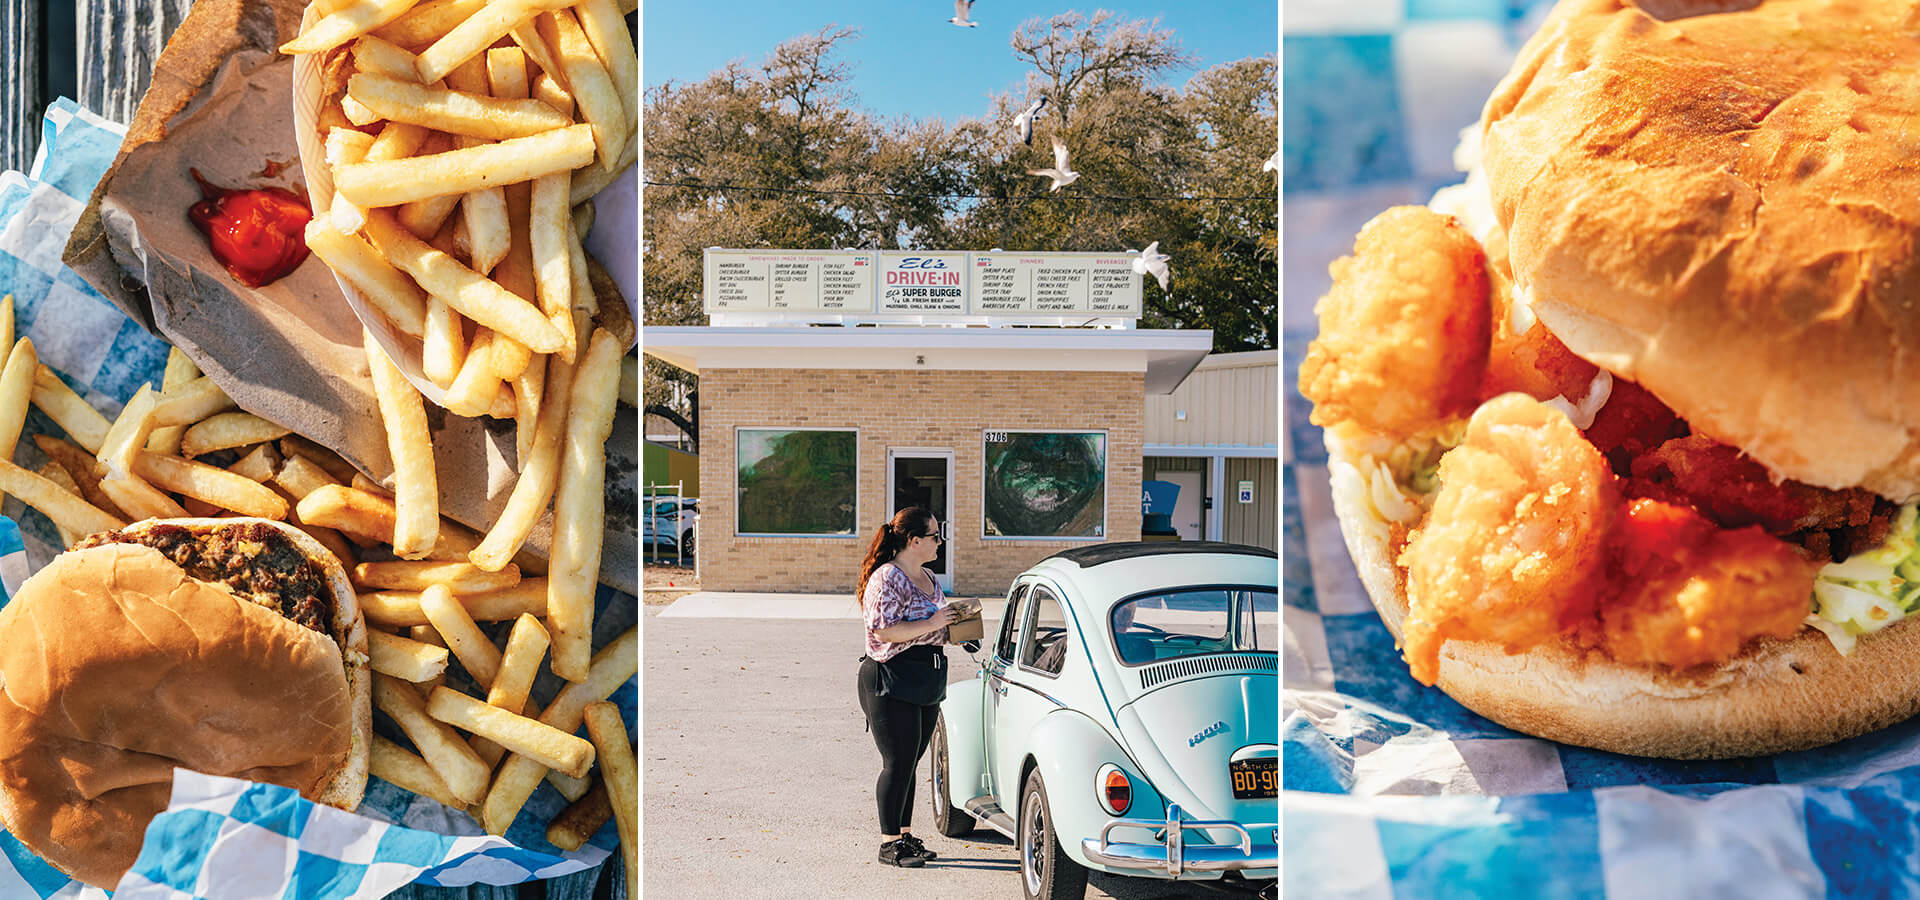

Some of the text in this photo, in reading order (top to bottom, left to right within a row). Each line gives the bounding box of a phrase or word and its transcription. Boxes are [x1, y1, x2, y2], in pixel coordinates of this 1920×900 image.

[898, 258, 948, 269] El's
[902, 288, 928, 297] SUPER
[930, 288, 961, 297] BURGER
[985, 432, 1007, 441] 3706
